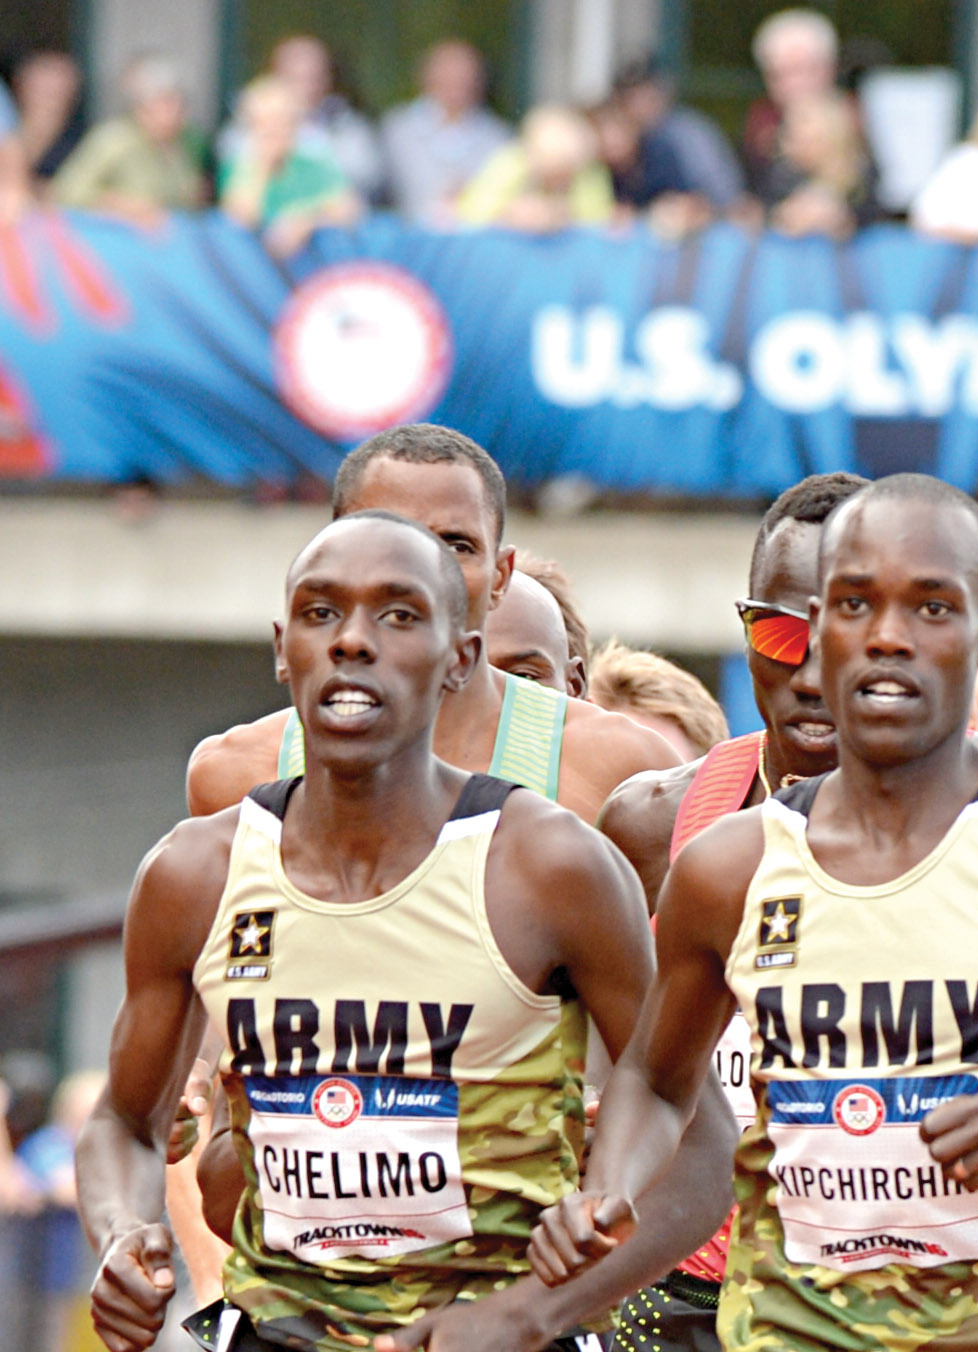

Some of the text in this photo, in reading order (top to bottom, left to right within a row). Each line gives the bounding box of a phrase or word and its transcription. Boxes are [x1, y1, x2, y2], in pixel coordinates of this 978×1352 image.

[532, 304, 742, 410] U.S.
[227, 998, 475, 1078] ARMY
[396, 1094, 441, 1106] USATF
[262, 1145, 448, 1200] CHELIMO
